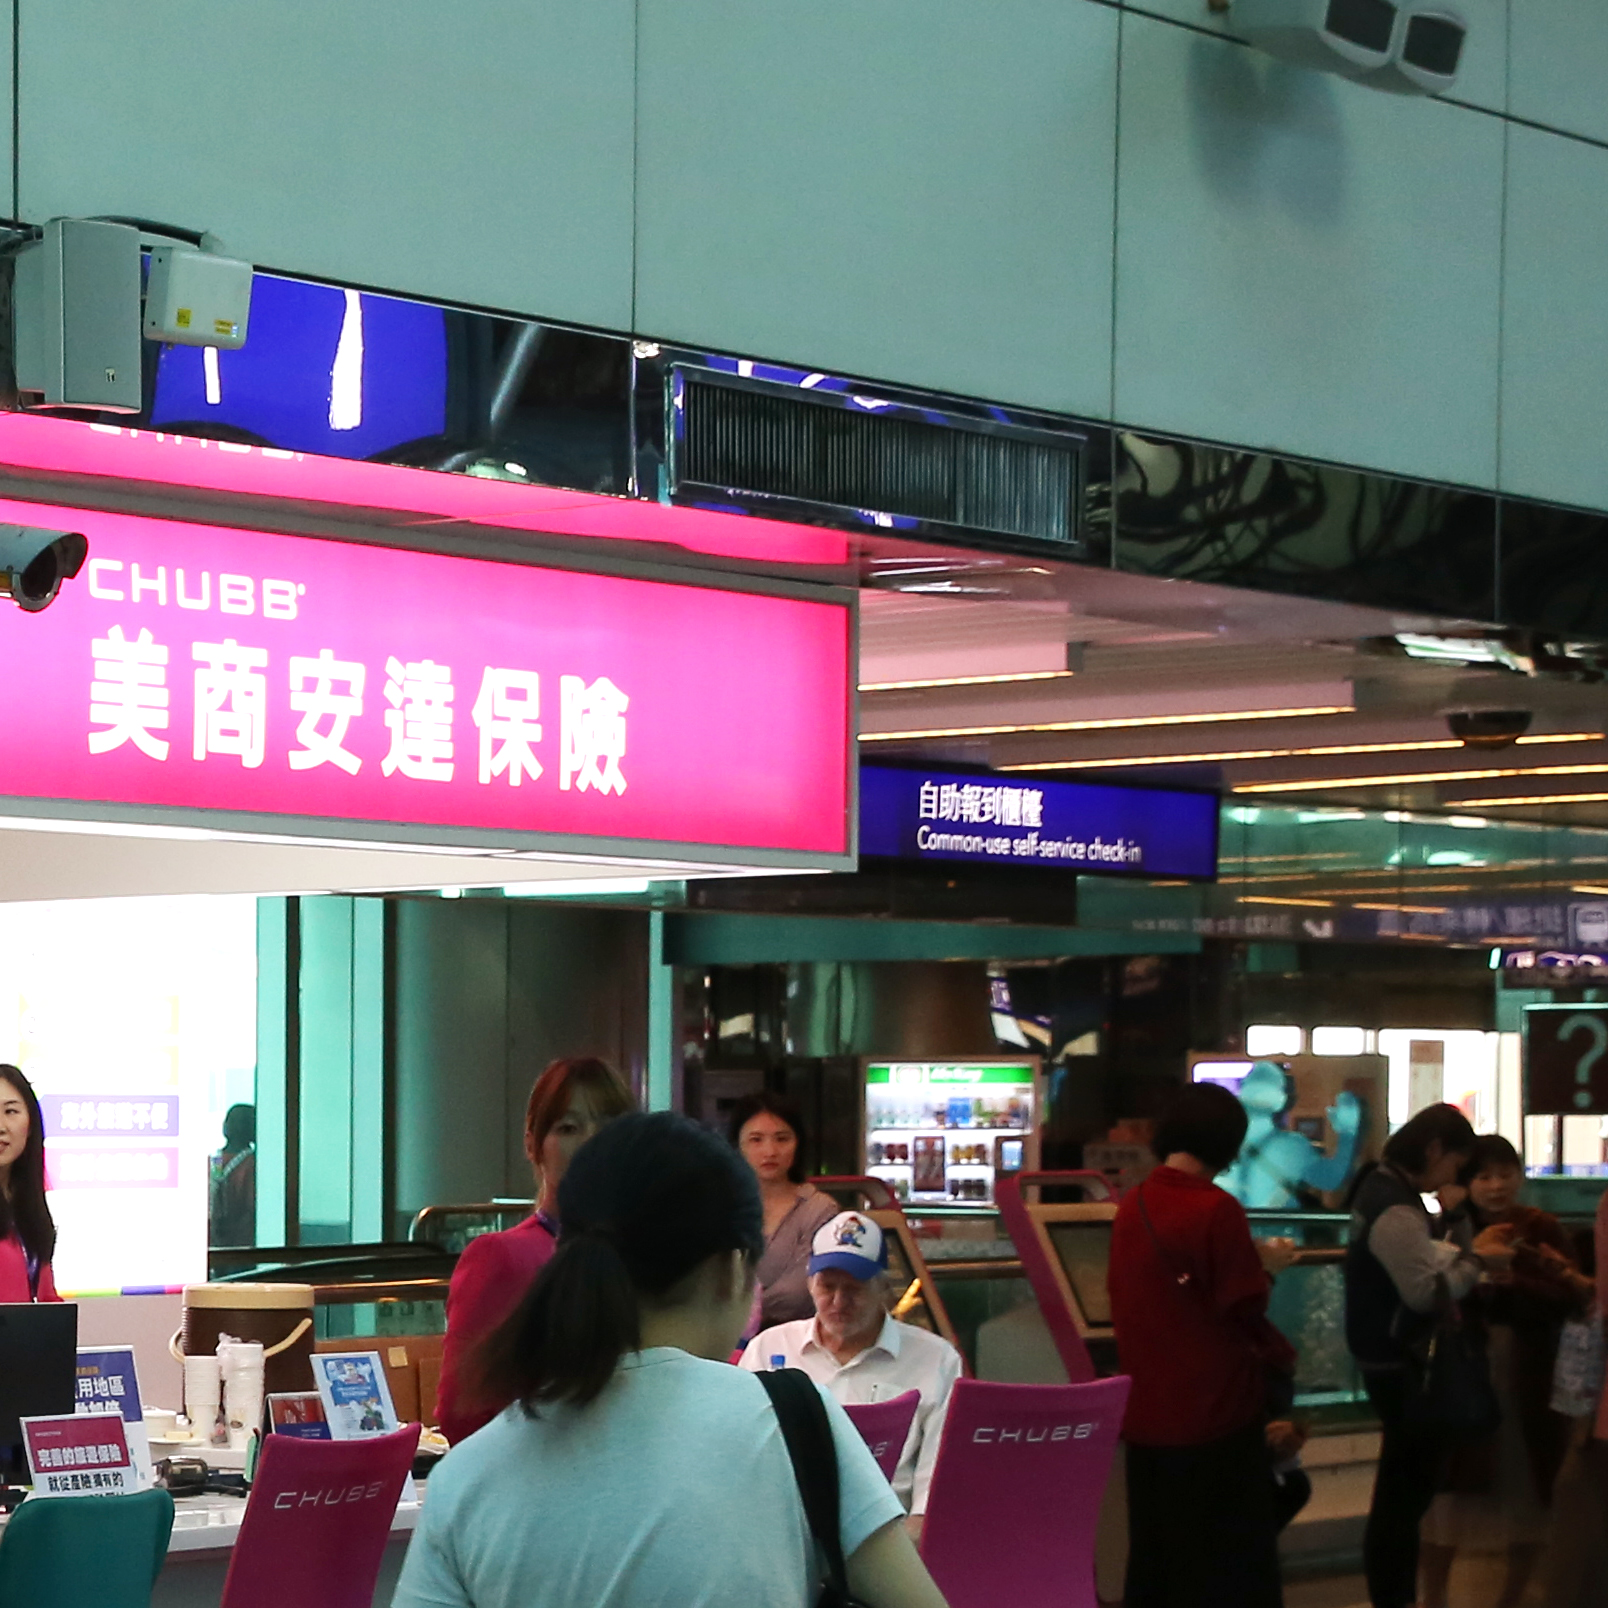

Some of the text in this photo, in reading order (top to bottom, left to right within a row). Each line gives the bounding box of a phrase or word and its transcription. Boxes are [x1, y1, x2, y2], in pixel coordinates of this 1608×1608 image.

[87, 558, 304, 620] CHUBB
[87, 625, 630, 797] 美商安達保險
[916, 825, 1142, 863] Common-use self-service check-in
[75, 1375, 126, 1398] 用地區
[973, 1423, 1095, 1444] CHUBB
[274, 1482, 383, 1510] CHUBB
